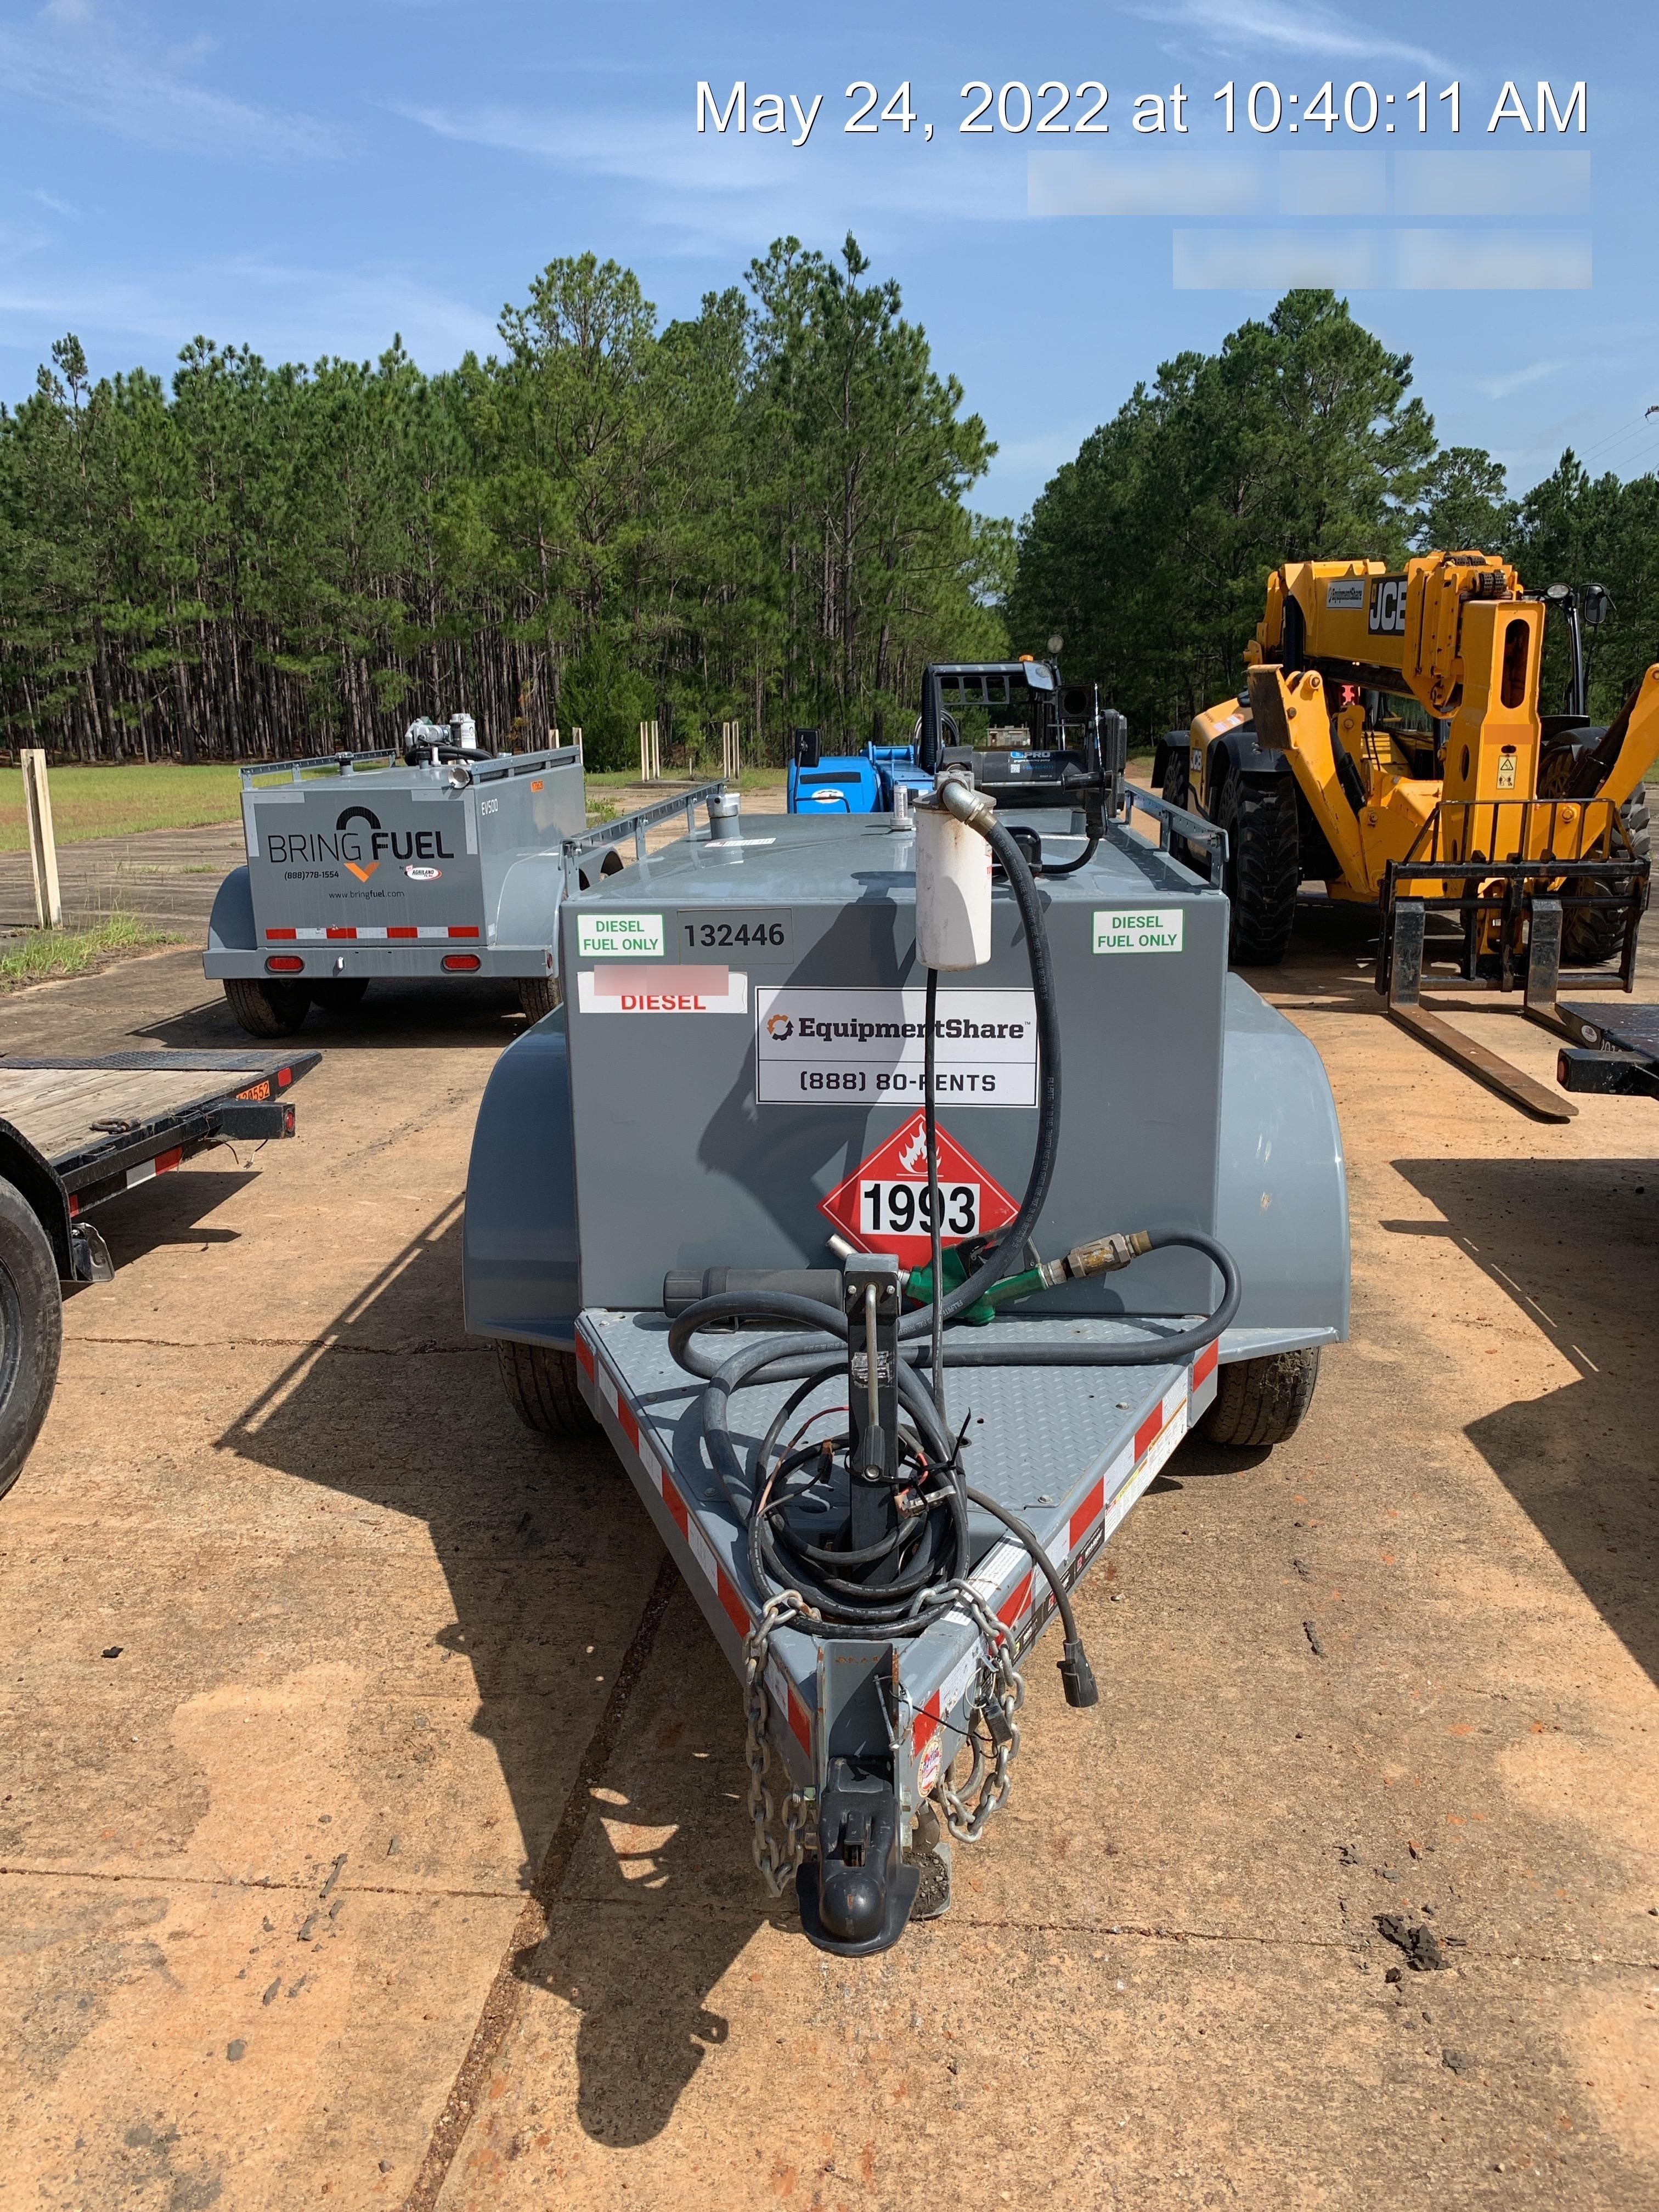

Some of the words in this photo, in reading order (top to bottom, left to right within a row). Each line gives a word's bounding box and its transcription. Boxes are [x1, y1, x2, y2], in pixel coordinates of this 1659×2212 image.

[482, 798, 498, 816] EV500
[268, 833, 362, 863] BRING
[371, 831, 454, 861] FUEL
[284, 871, 339, 881] (888)778-1554
[329, 890, 404, 900] www.bringfuel.com
[595, 920, 645, 932] DIESEL
[1111, 916, 1163, 928] DIESEL
[684, 923, 785, 947] 132446
[1098, 935, 1135, 947] FUEL
[1139, 934, 1177, 946] ONLY
[583, 938, 618, 951] FUEL
[622, 938, 658, 950] ONLY
[621, 996, 706, 1010] DIESEL
[800, 1071, 866, 1092] (888)
[239, 1082, 269, 1100] 20552
[864, 1183, 975, 1234] 1993
